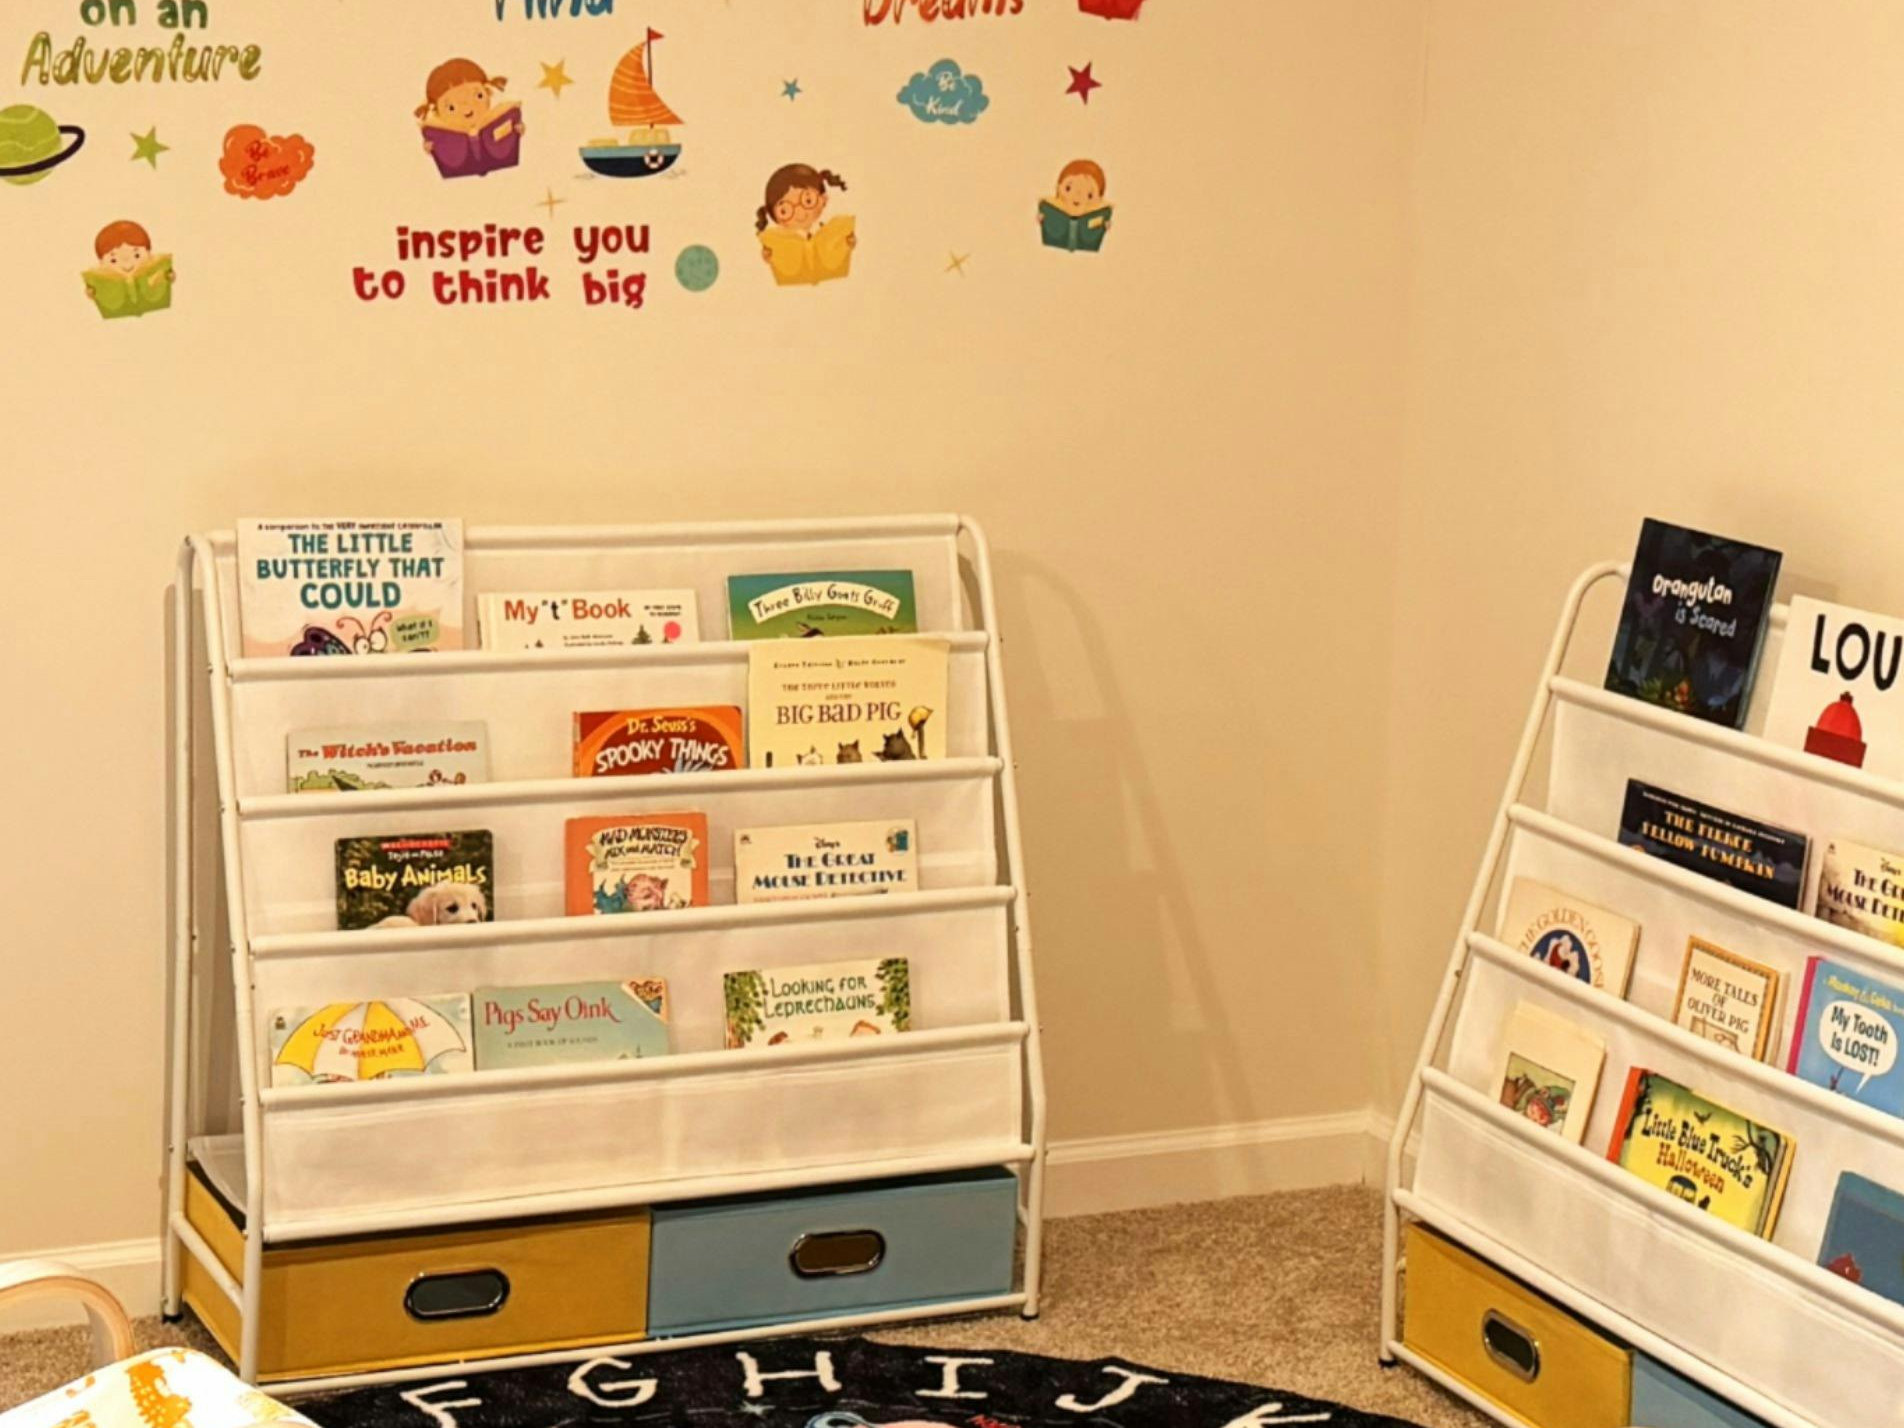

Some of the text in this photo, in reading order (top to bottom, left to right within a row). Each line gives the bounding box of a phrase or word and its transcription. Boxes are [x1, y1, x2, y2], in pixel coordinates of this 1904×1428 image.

[21, 31, 262, 87] Adventure
[934, 70, 957, 93] Be
[925, 96, 962, 118] Kind
[246, 141, 271, 163] Be
[397, 224, 650, 262] inspire you
[352, 266, 647, 309] to think big
[336, 521, 356, 530] VERY
[287, 532, 414, 554] THE LITTLE
[256, 557, 445, 580] BUTTERFLY THAT
[300, 581, 402, 610] COULD
[753, 583, 896, 619] Three Billy Goats Gruff
[1652, 574, 1733, 607] Orangutan
[504, 599, 539, 625] My
[572, 597, 632, 620] Book
[1675, 600, 1737, 638] is Scared
[1810, 613, 1904, 692] LOU
[626, 715, 697, 736] Dr. Seuss's
[776, 704, 814, 725] BIG
[866, 701, 902, 722] PIG
[298, 738, 478, 760] The Witch's Vacation
[595, 737, 729, 773] SPOOKY THINGS
[1665, 810, 1695, 832] THE
[1697, 823, 1753, 853] FIERCE
[345, 864, 398, 891] Baby
[1701, 844, 1775, 880] PUMPKIN
[770, 976, 835, 998] LOOKING
[1691, 967, 1759, 1007] MORE TALES
[1712, 992, 1728, 1009] OF
[485, 995, 624, 1035] Pigs Say Oink
[1687, 997, 1750, 1033] OLIVER PIG
[1830, 1005, 1889, 1045] My Tooth
[1844, 1037, 1880, 1067] LOST!
[1642, 1107, 1753, 1189] Little Blue Truck's
[1656, 1141, 1725, 1194] Halloween
[568, 1357, 658, 1408] G
[737, 1351, 842, 1397] H
[916, 1356, 993, 1399] I
[1056, 1366, 1169, 1412] J
